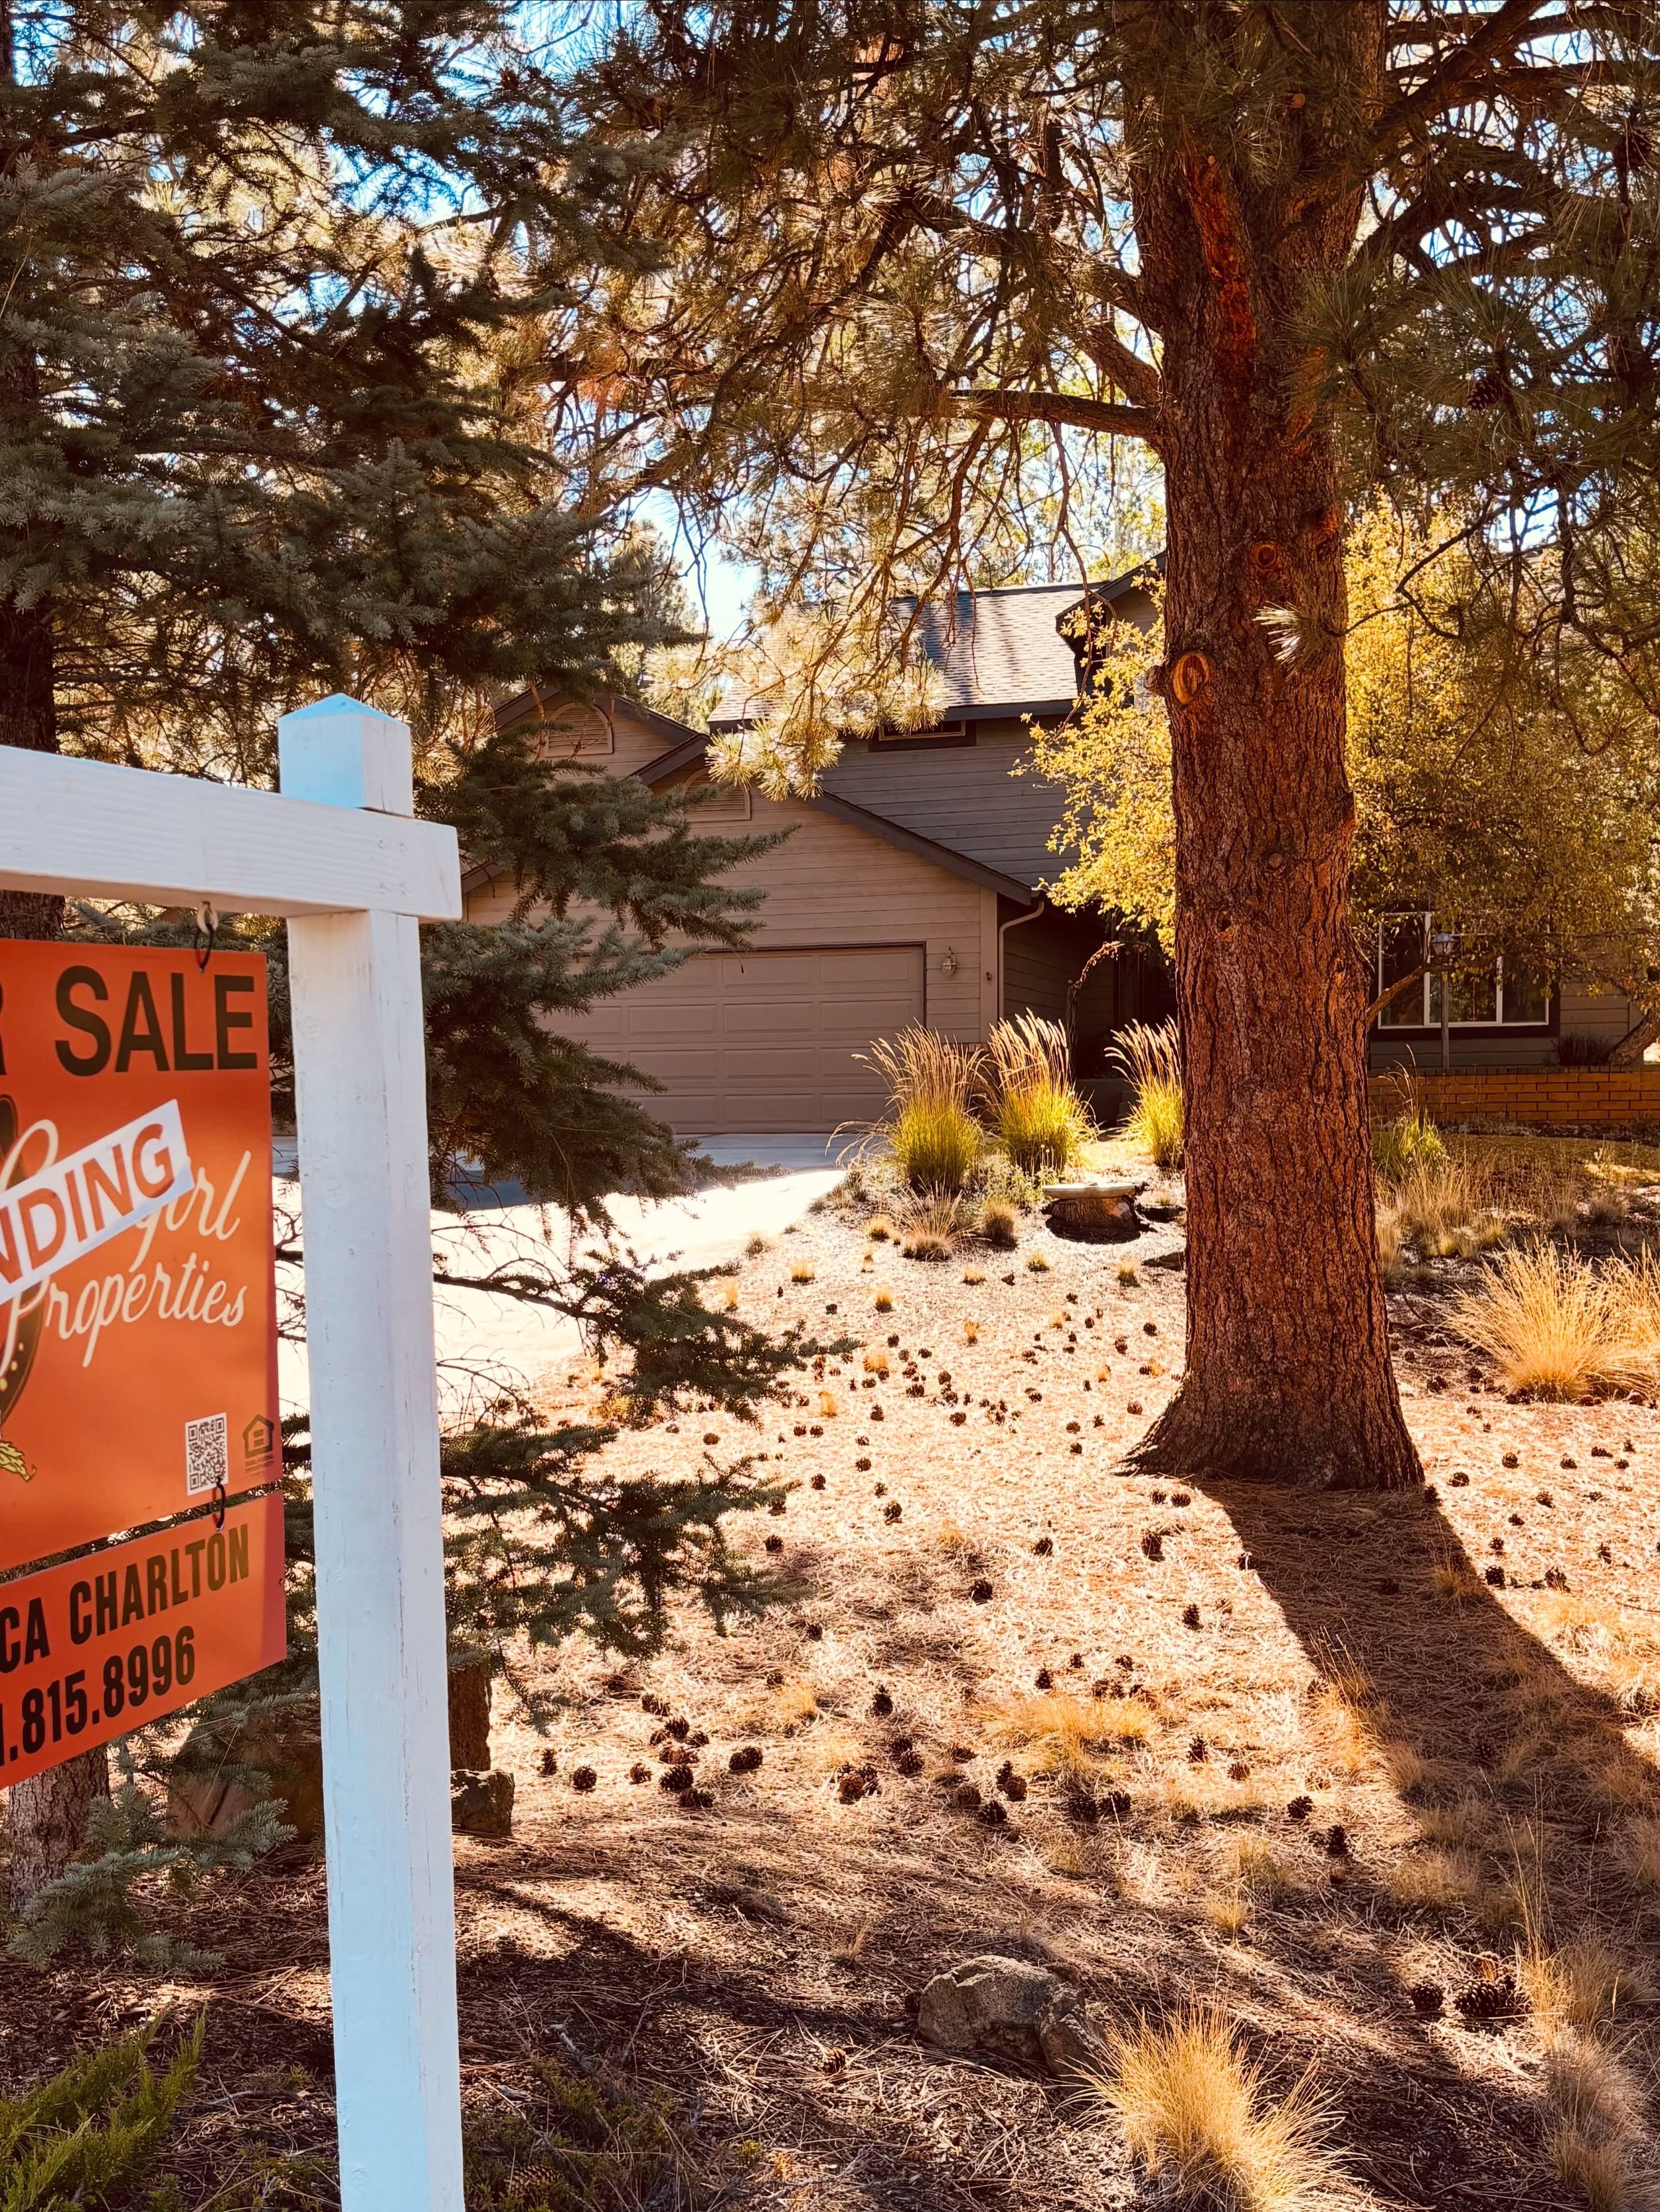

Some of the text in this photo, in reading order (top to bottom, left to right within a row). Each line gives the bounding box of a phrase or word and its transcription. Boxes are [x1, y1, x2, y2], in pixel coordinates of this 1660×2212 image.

[55, 965, 258, 1077] SALE
[0, 1524, 249, 1674] CA CHARLTON
